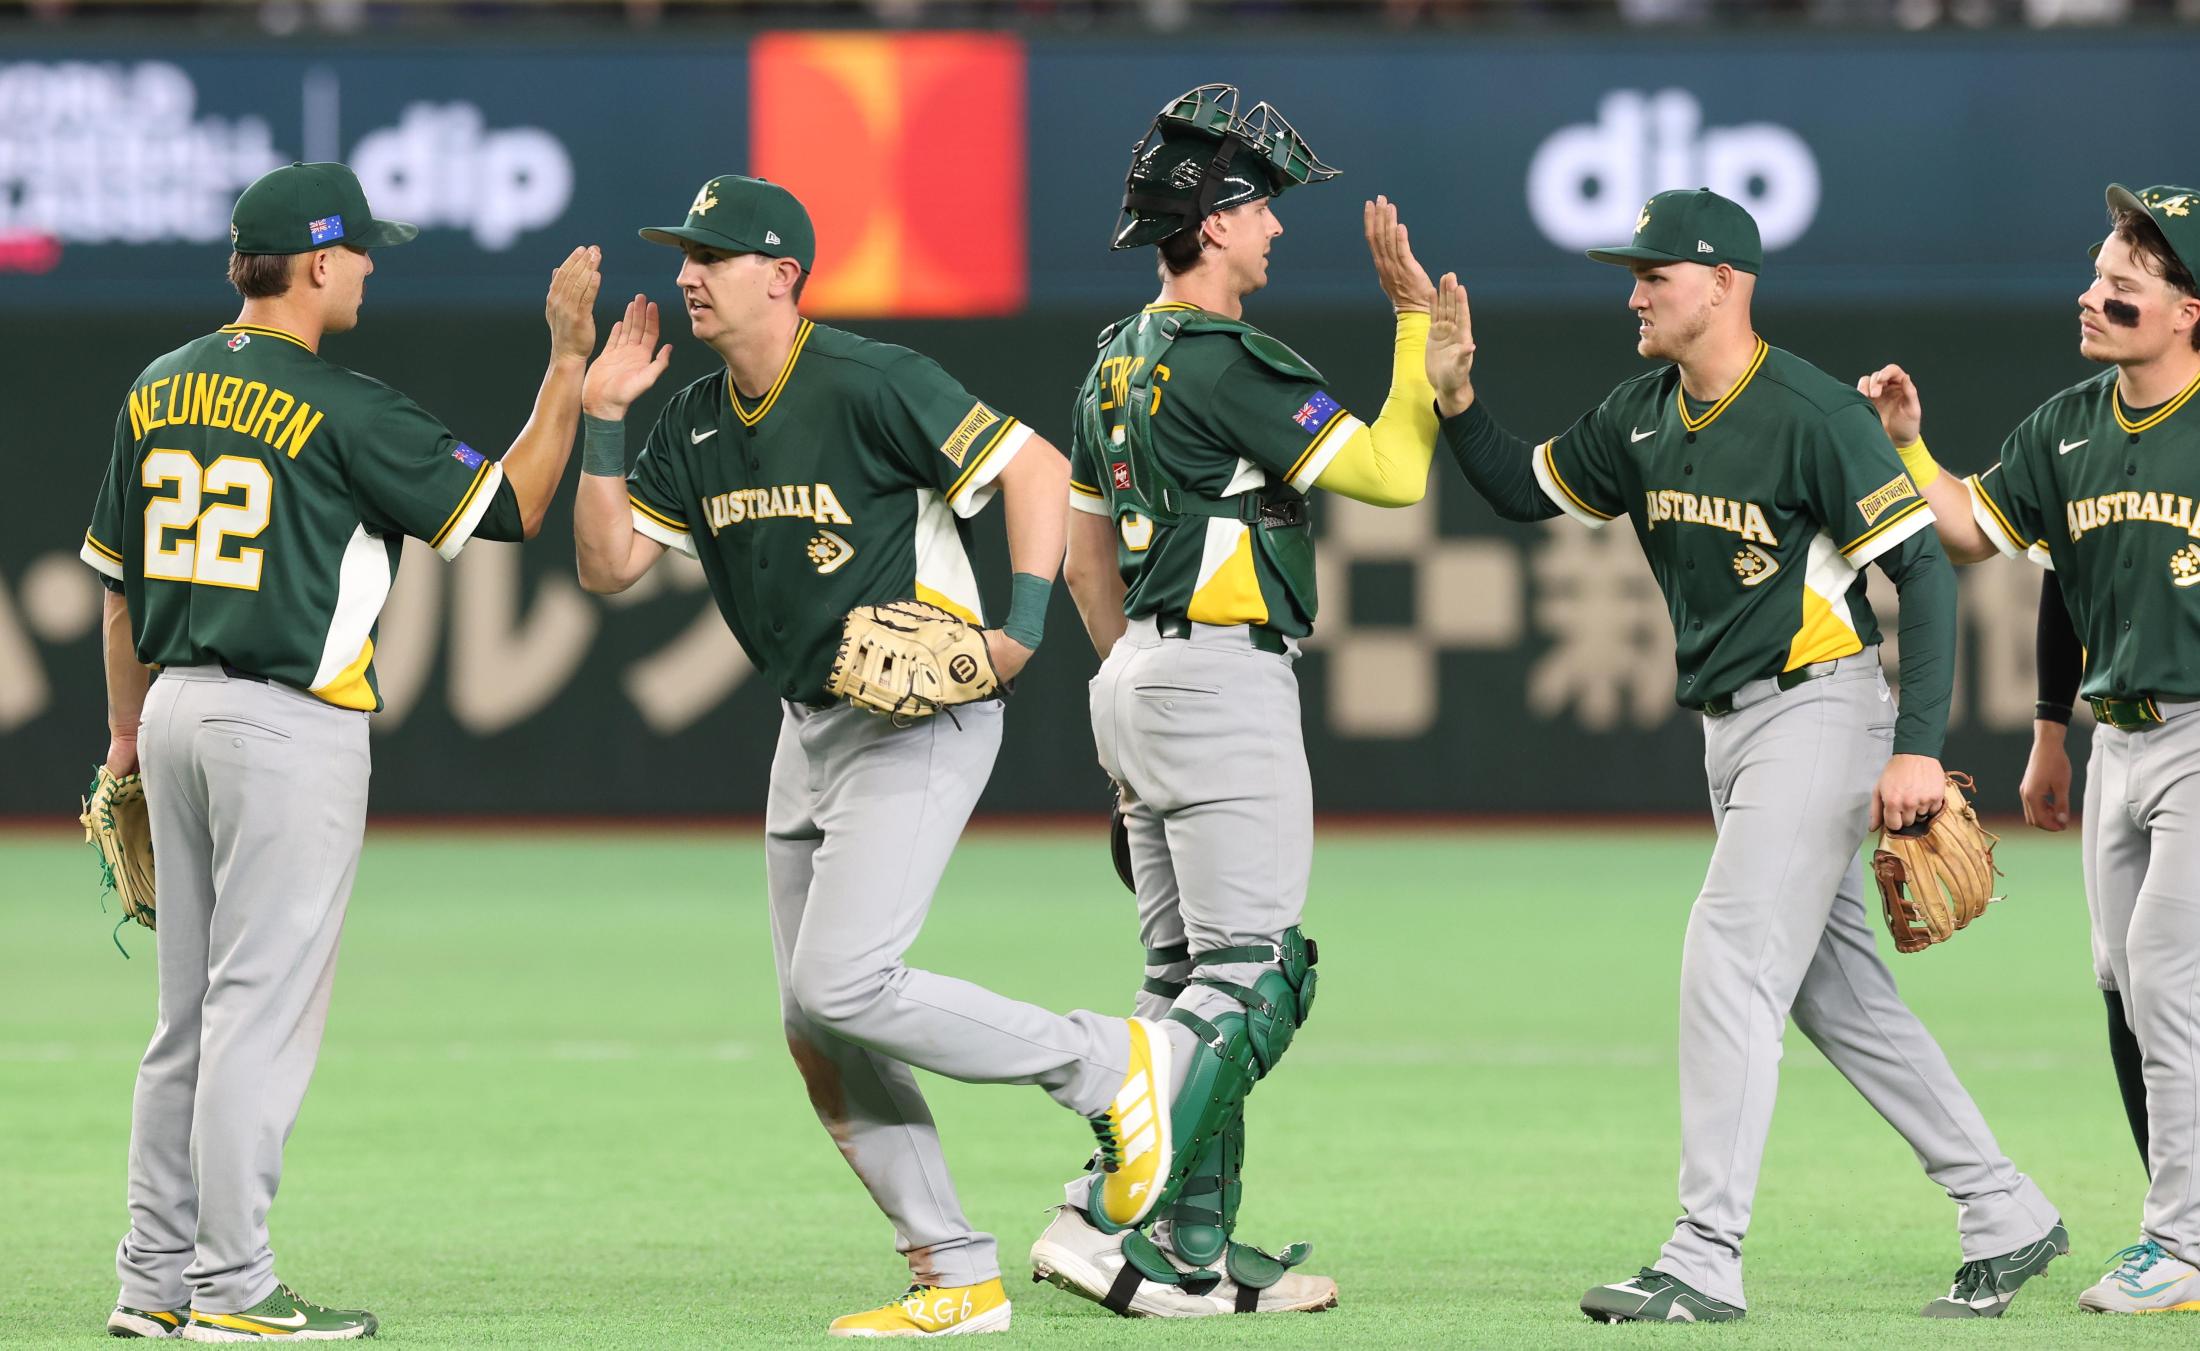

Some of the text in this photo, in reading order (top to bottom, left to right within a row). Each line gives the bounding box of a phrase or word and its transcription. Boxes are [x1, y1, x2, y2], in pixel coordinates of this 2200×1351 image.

[129, 372, 325, 460] NEUNBORN
[964, 407, 991, 436] TWENTY
[141, 447, 274, 592] 22
